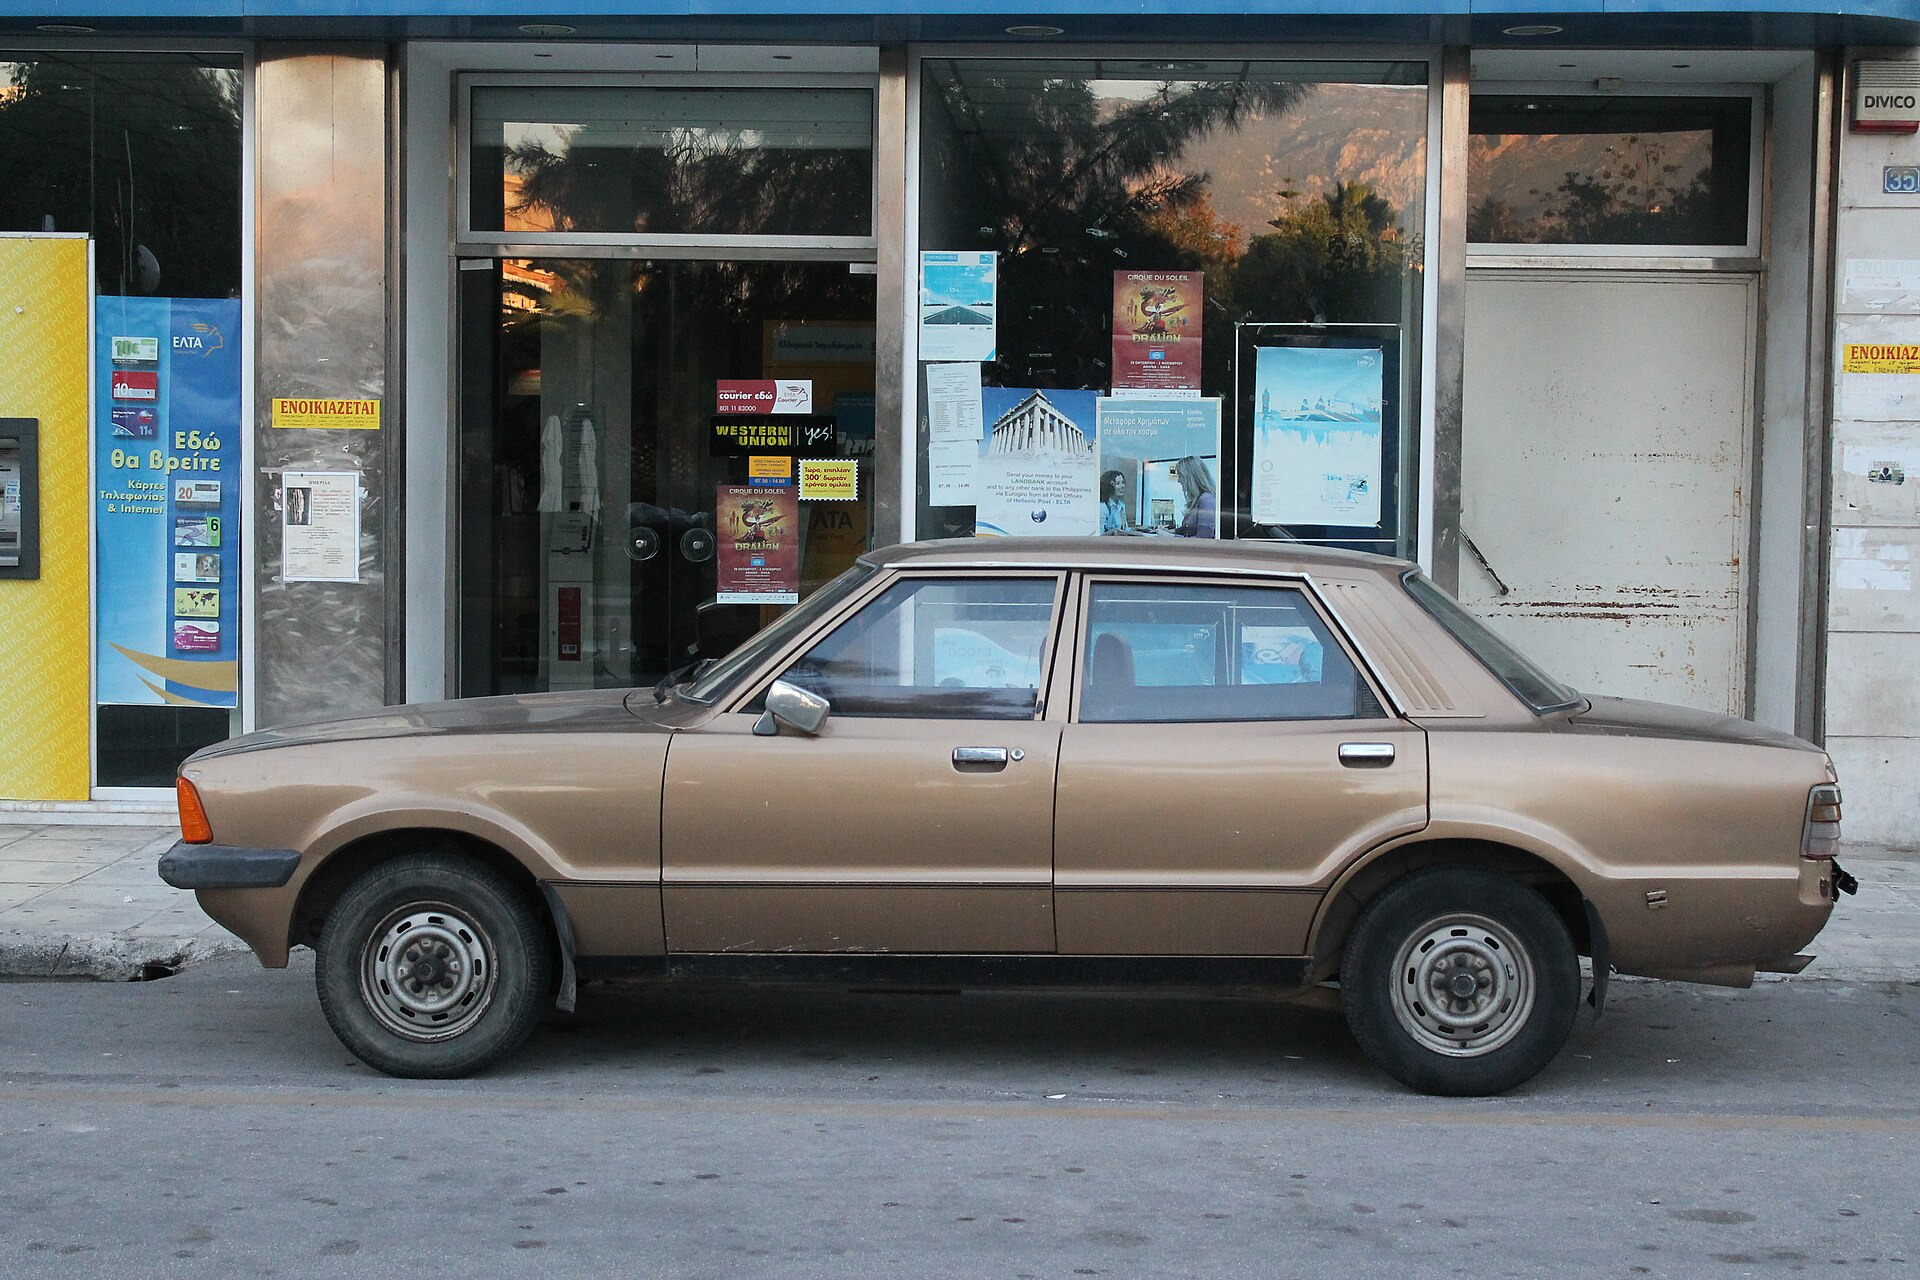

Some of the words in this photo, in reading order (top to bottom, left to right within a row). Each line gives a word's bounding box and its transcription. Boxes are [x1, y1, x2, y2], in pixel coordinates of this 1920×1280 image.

[1864, 95, 1916, 109] DIVICO
[1889, 169, 1915, 191] 35
[173, 336, 203, 348] ΕΛΤΑ
[1851, 346, 1920, 360] ΕΝΟΙΚΙΑΖ
[719, 391, 752, 399] courier
[755, 391, 773, 399] εδώ
[281, 401, 374, 414] ΕΝΟΙΚΙΑΖΕΤΑΙ
[1104, 416, 1136, 426] Μεταφορά
[1138, 417, 1169, 426] Χρημάτων
[175, 430, 221, 450] Εδώ
[716, 426, 788, 435] WESTERN
[805, 424, 833, 446] yes!
[739, 436, 788, 446] UNION
[111, 449, 140, 468] θα
[150, 450, 221, 475] βρείτε
[128, 480, 165, 491] Κάρτες
[101, 490, 165, 502] Τηλεφωνίας
[178, 487, 193, 499] 20
[108, 504, 117, 513] &
[121, 505, 164, 514] Internet
[211, 519, 218, 531] 6
